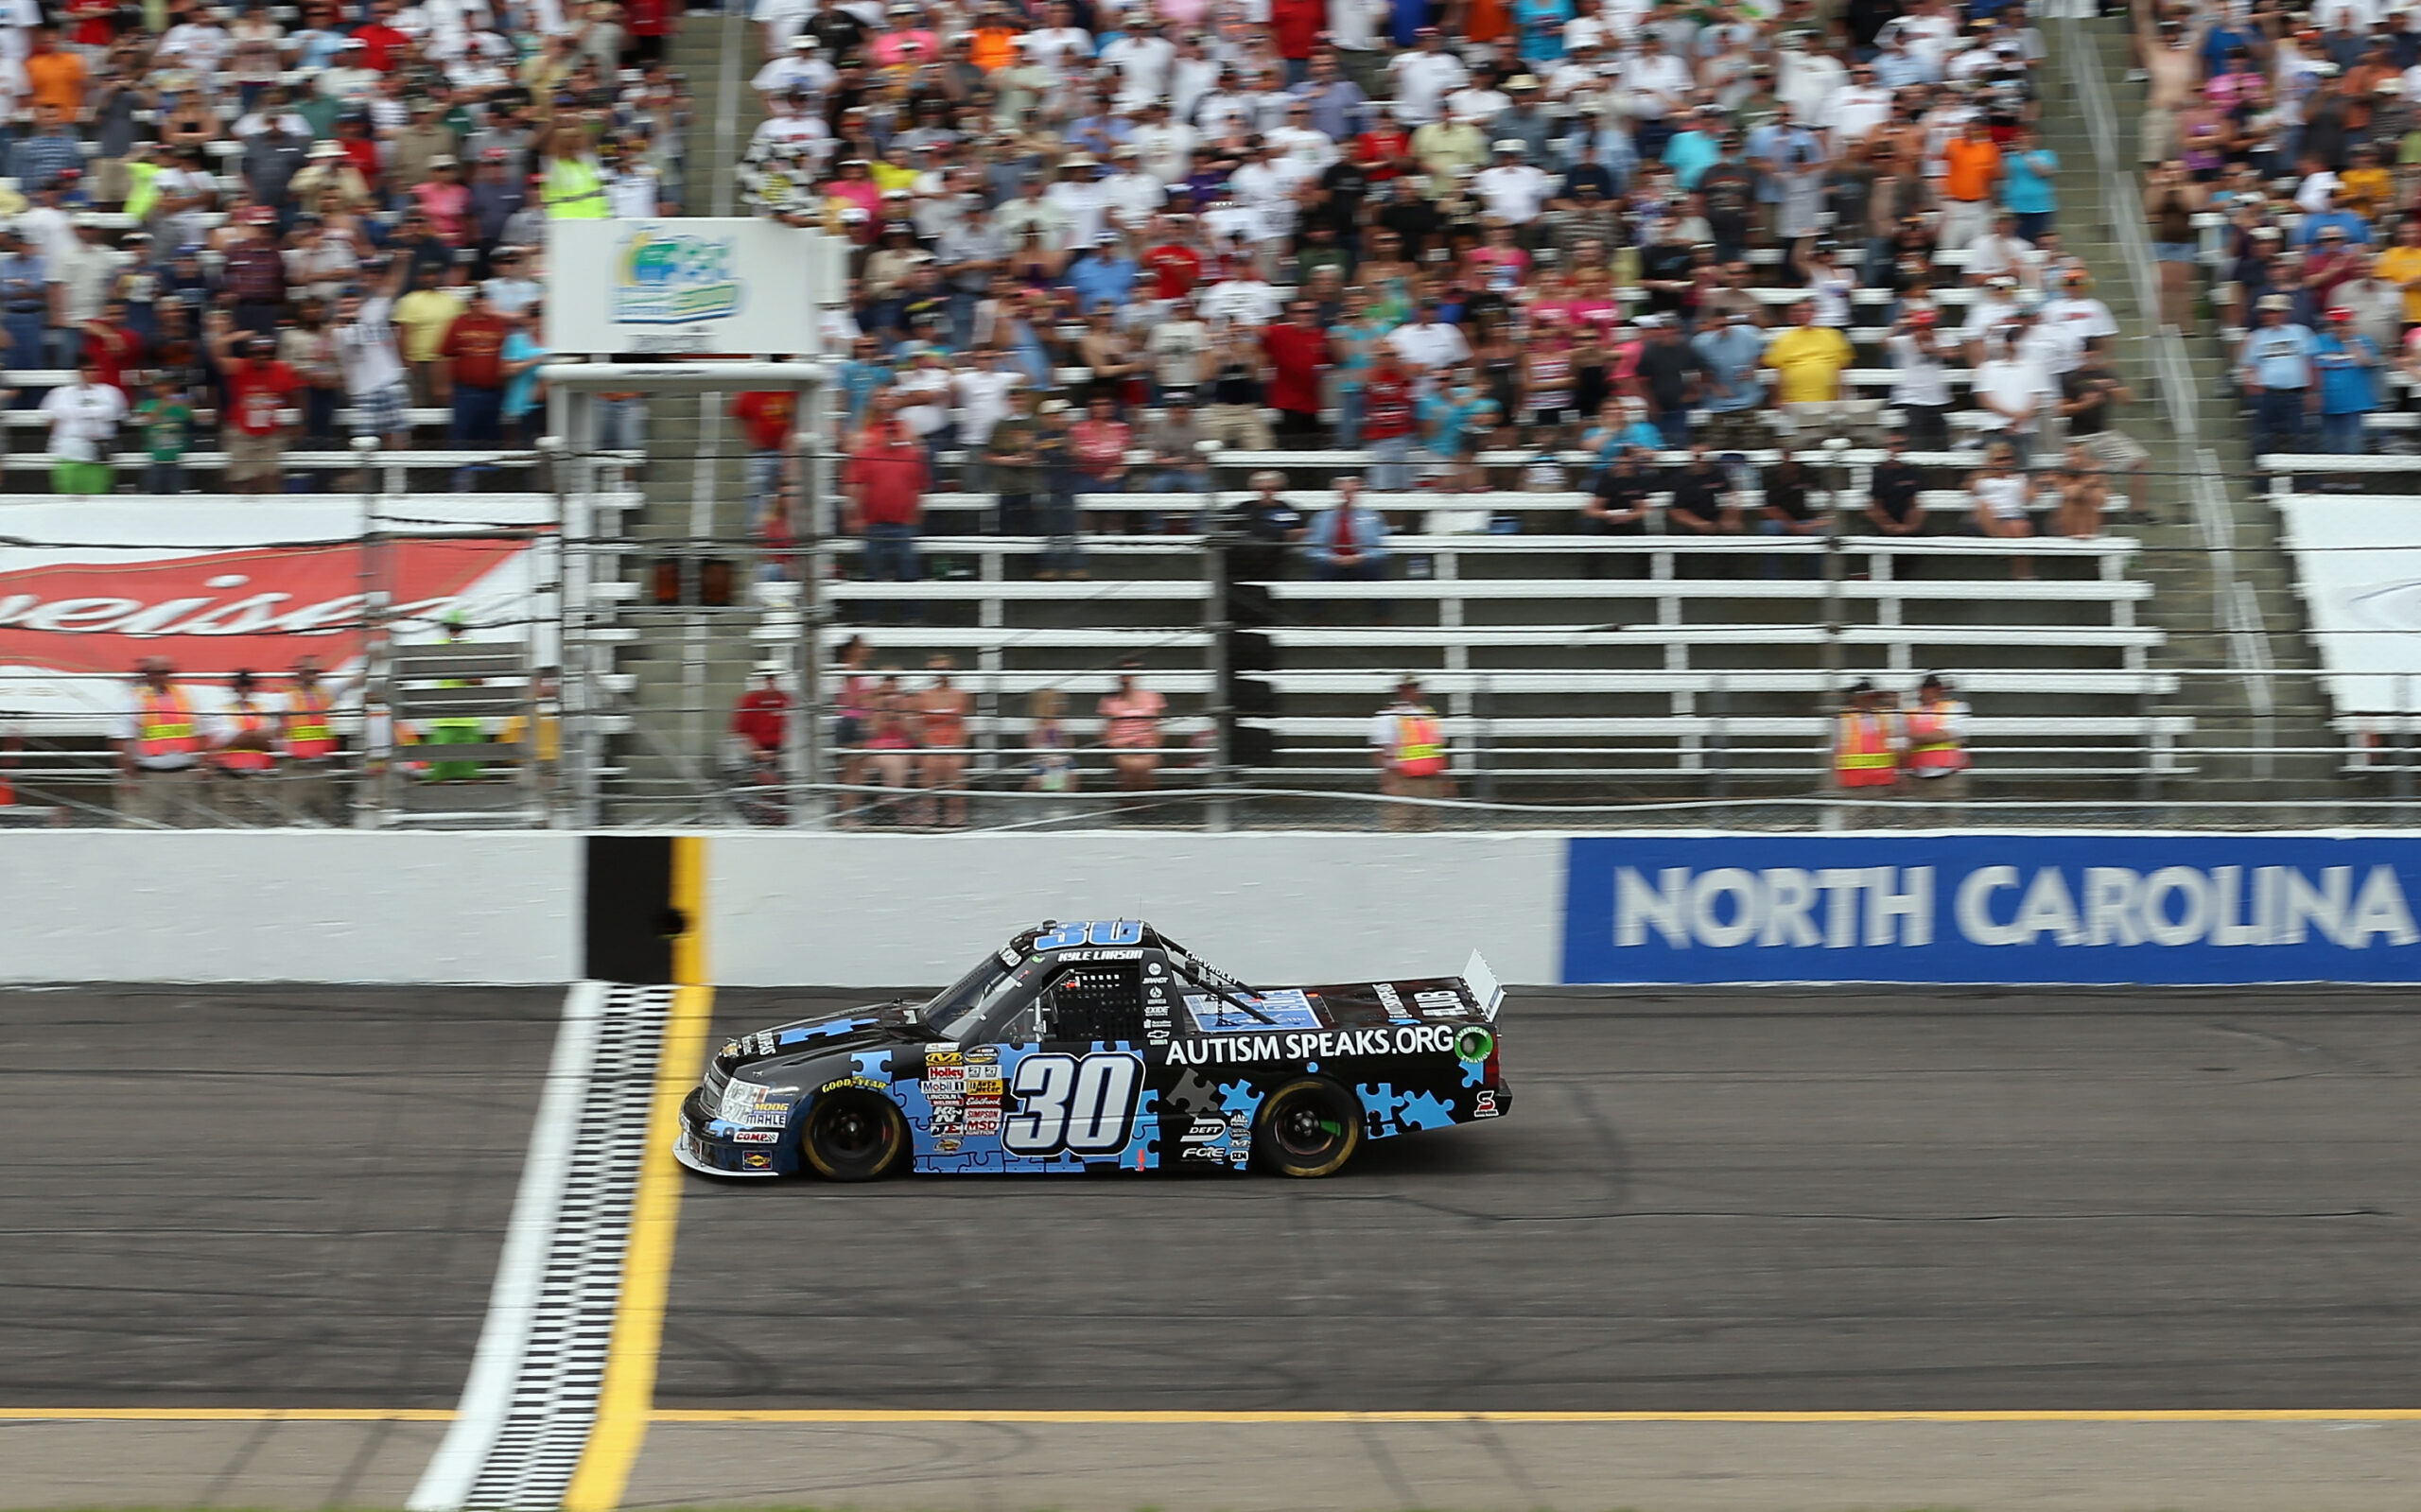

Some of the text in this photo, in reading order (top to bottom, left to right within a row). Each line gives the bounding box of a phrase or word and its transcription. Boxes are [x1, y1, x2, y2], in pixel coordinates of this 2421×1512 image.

[1613, 863, 2421, 949] NORTH CAROLINA
[1057, 949, 1144, 963] KYLE LARSON
[1185, 950, 1238, 984] CHEVROLET
[1455, 1026, 1491, 1043] AMERICAN
[1165, 1024, 1454, 1065] AUTISM SPEAKS.ORG
[1461, 1051, 1491, 1065] ETHANOL
[930, 1068, 964, 1080] Holley
[822, 1077, 887, 1093] GOODYEAR
[924, 1081, 964, 1091] Mobil 1
[1004, 1055, 1141, 1153] 30
[748, 1115, 786, 1125] MAHLE
[967, 1121, 997, 1131] MSD
[932, 1123, 961, 1136] JE
[737, 1134, 768, 1142] COMP
